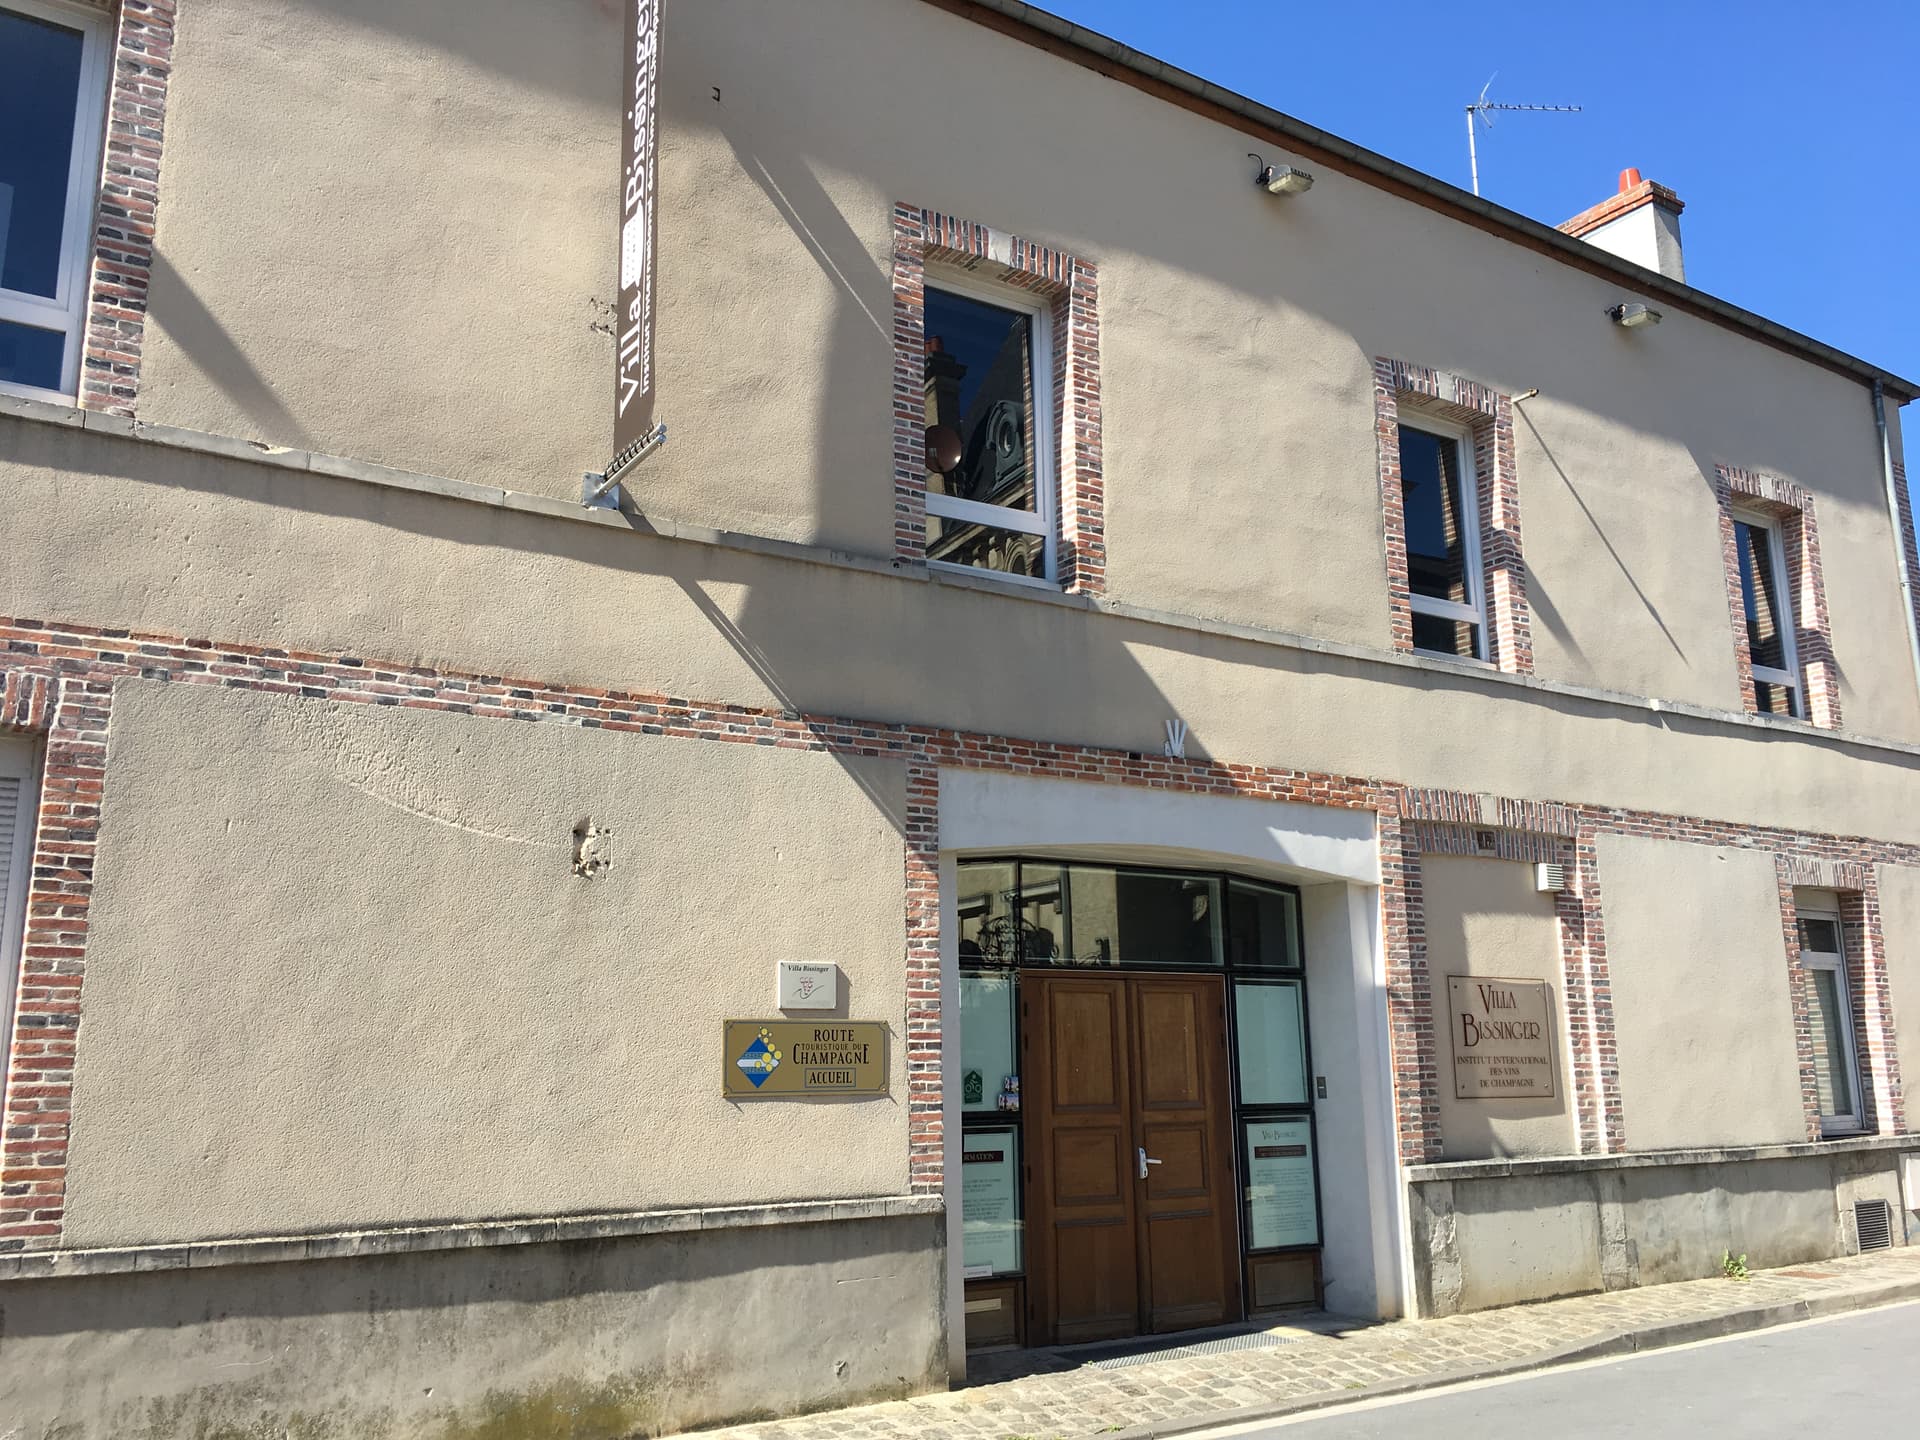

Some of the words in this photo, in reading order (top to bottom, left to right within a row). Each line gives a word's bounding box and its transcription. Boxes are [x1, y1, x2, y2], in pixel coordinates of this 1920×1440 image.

[650, 83, 656, 108] de
[625, 0, 653, 216] Bissinger
[644, 195, 652, 320] International
[620, 290, 641, 419] Villa
[642, 321, 651, 395] Institut
[788, 963, 802, 972] Villa
[1477, 984, 1517, 1014] VILLA
[814, 1029, 855, 1042] ROUTE
[1461, 1013, 1540, 1047] BISSINGER
[793, 1043, 869, 1065] CHAMPAGNE
[801, 1043, 848, 1051] TOURISTIQUE
[852, 1043, 862, 1051] DU
[1457, 1056, 1491, 1065] INSTITUT
[1493, 1055, 1548, 1065] INTERNATIONAL
[809, 1071, 852, 1084] ACCUEIL
[1489, 1067, 1503, 1076] DES
[1504, 1067, 1521, 1076] VINS
[1480, 1079, 1490, 1089] DE
[1491, 1078, 1535, 1088] CHAMPAGNE
